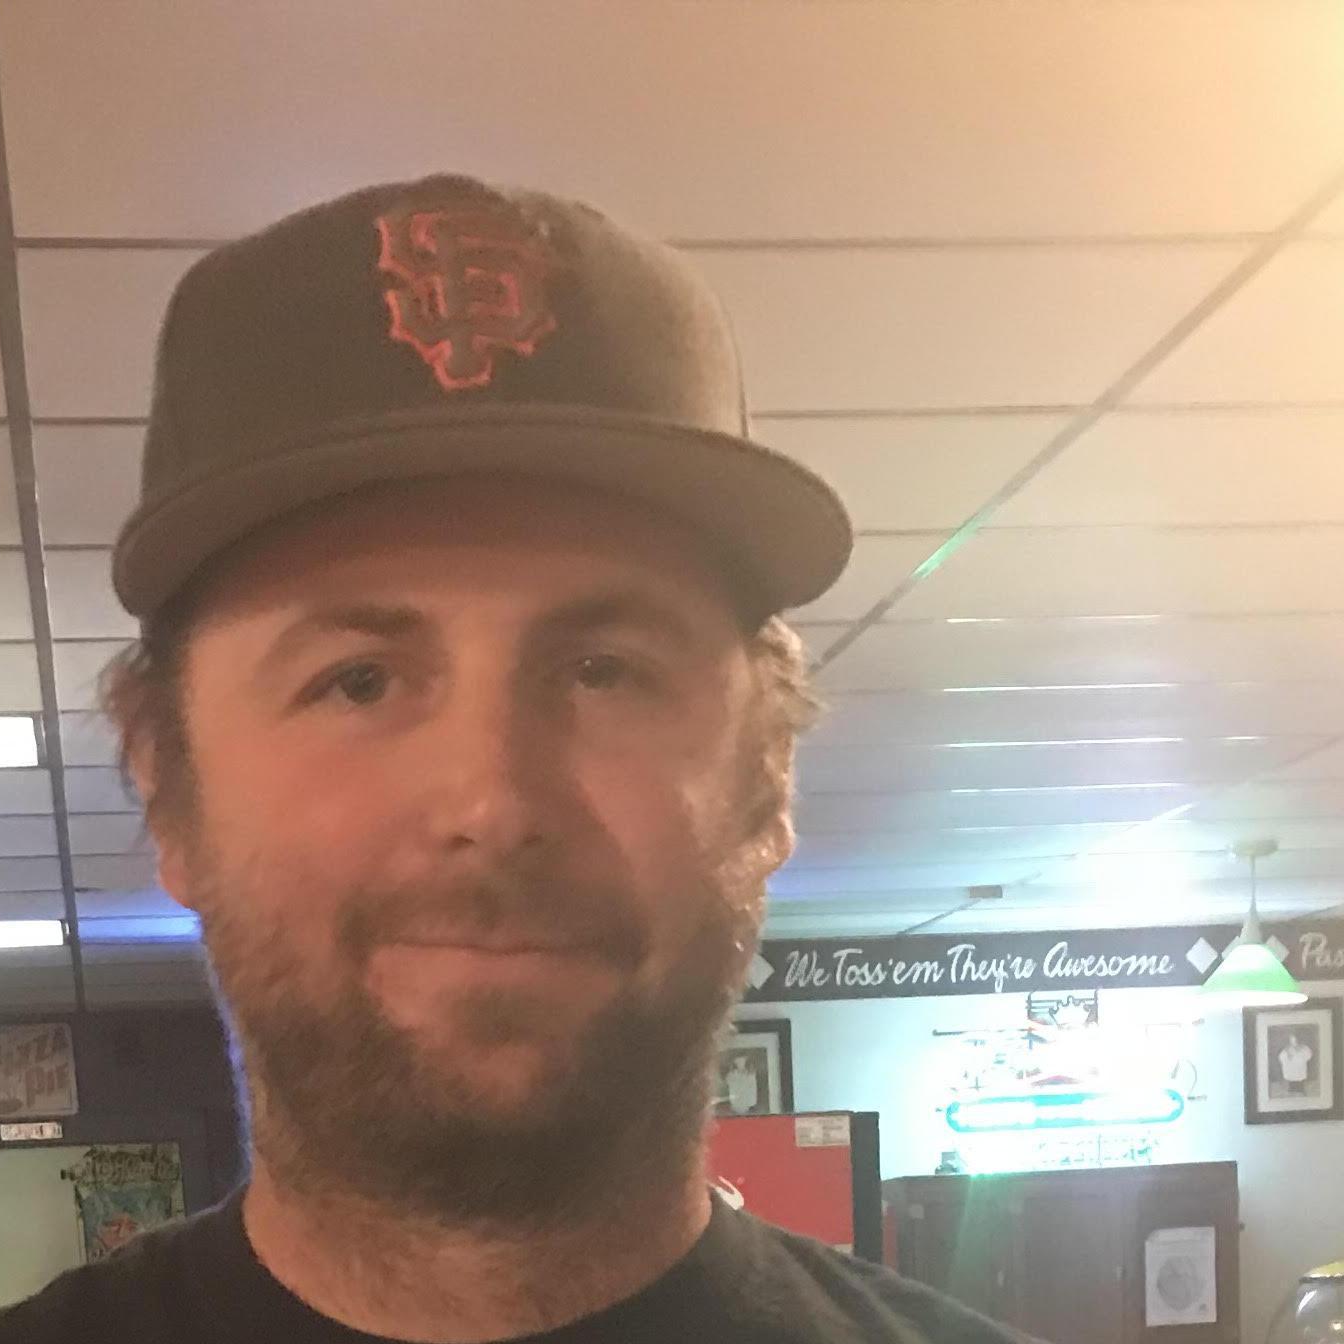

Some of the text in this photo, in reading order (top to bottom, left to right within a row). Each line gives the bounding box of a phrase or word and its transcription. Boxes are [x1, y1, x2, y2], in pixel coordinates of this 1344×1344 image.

[785, 950, 829, 987] We
[947, 944, 1037, 993] They're
[1043, 941, 1174, 978] Awesome
